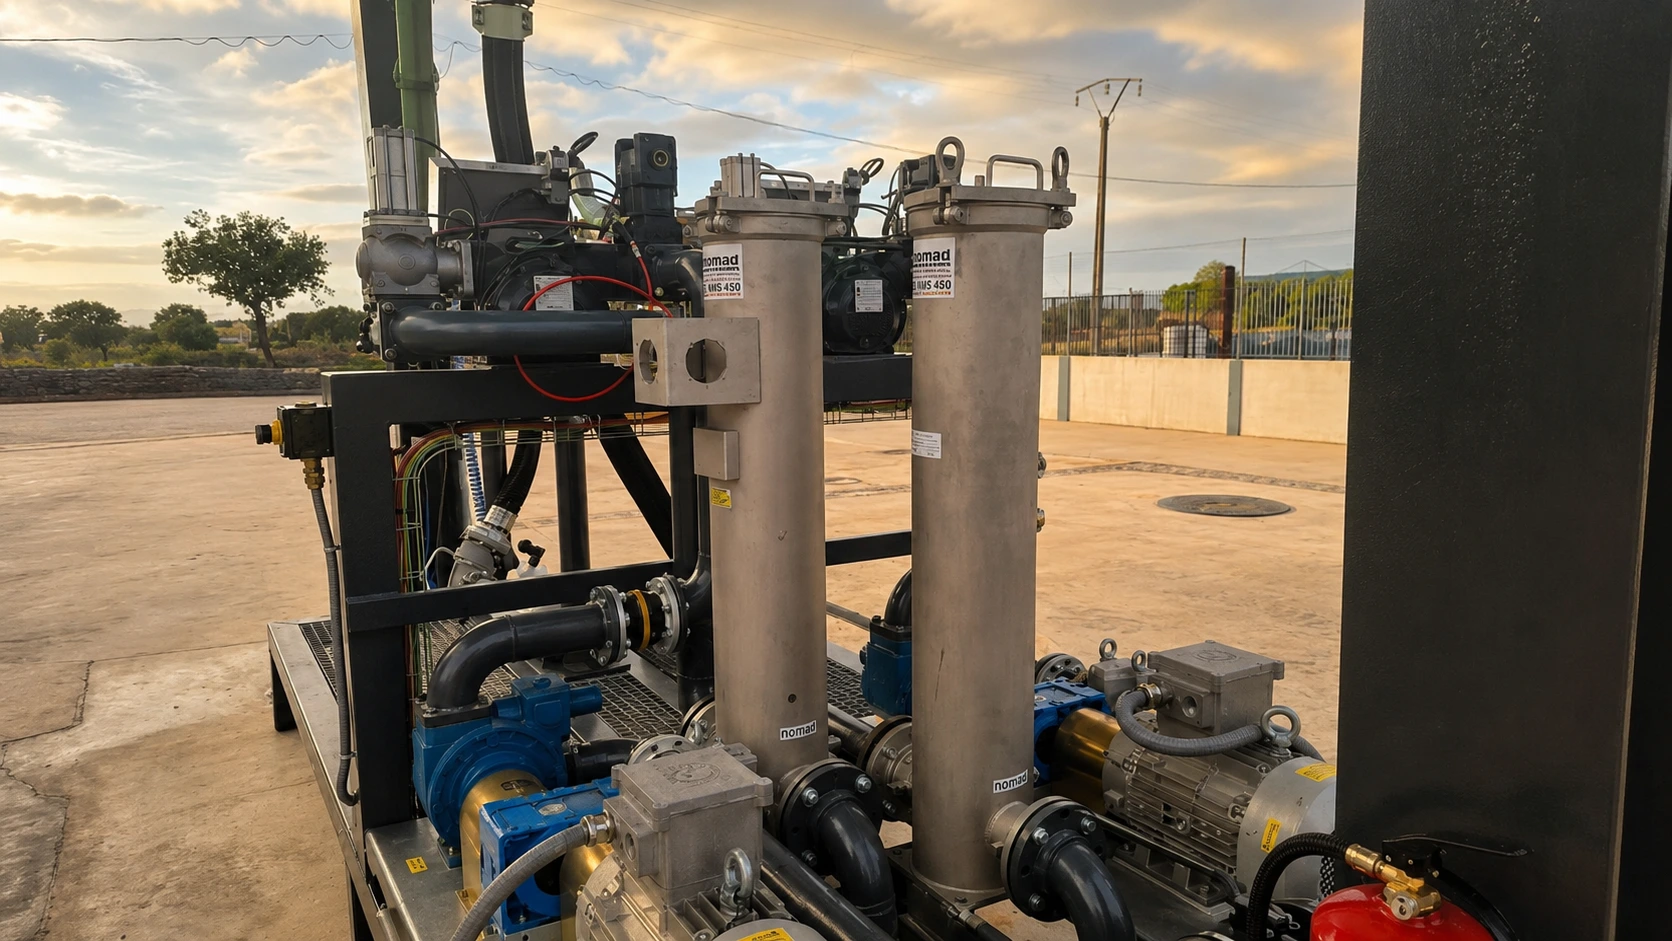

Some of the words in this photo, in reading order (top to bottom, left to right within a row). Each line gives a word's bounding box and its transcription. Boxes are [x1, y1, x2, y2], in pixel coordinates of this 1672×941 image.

[724, 282, 741, 292] 450
[934, 279, 952, 290] 450
[781, 721, 816, 739] nomad
[994, 771, 1027, 791] nomad
